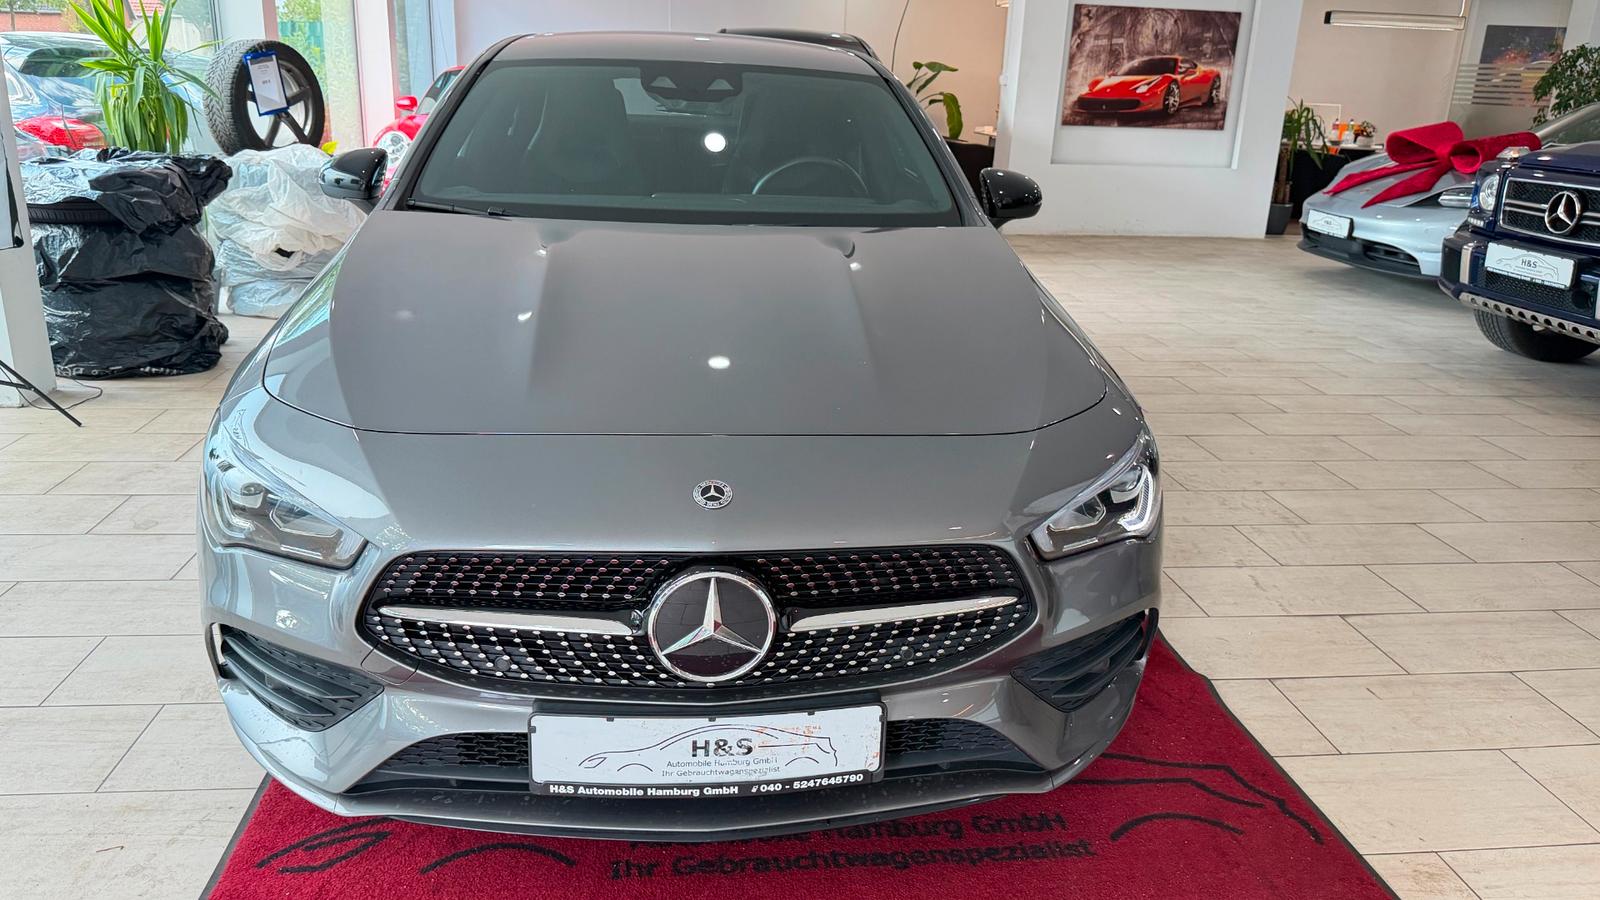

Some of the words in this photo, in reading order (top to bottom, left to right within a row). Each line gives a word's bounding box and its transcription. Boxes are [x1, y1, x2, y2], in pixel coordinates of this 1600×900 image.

[1521, 258, 1538, 269] H&S
[691, 738, 753, 757] H&S
[661, 769, 674, 777] Ihr
[666, 760, 712, 768] Automobile
[549, 784, 575, 794] H&S
[577, 786, 644, 796] Automobile
[647, 786, 700, 797] Hamburg
[703, 786, 739, 795] GmbH
[760, 783, 782, 792] 040
[793, 774, 864, 789] 5247645790
[970, 811, 1068, 834] GmbH
[611, 859, 660, 880] Ihr
